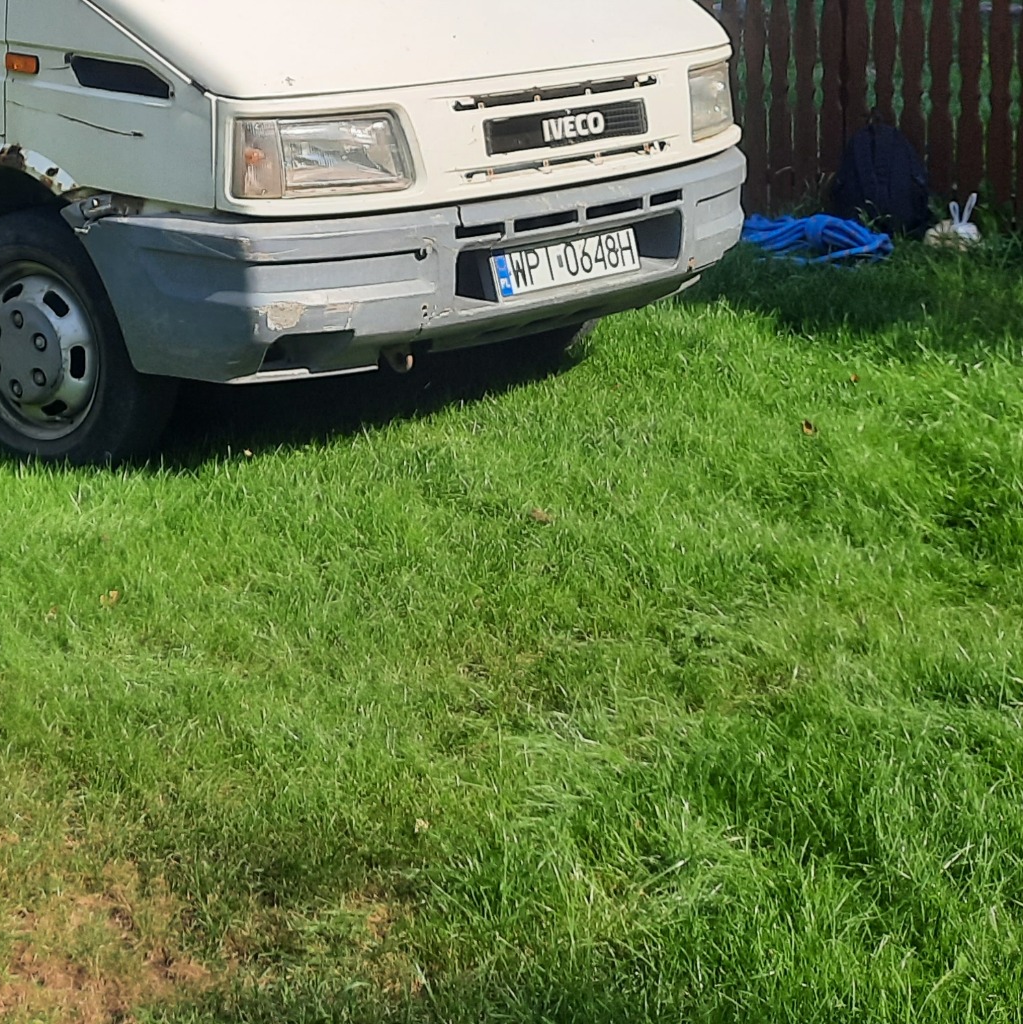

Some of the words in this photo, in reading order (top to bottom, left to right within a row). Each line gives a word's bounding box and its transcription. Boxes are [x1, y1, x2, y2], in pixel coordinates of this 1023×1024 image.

[542, 111, 605, 143] IVECO
[509, 246, 554, 288] WPI
[563, 230, 636, 277] 0648H
[500, 277, 511, 290] PL
